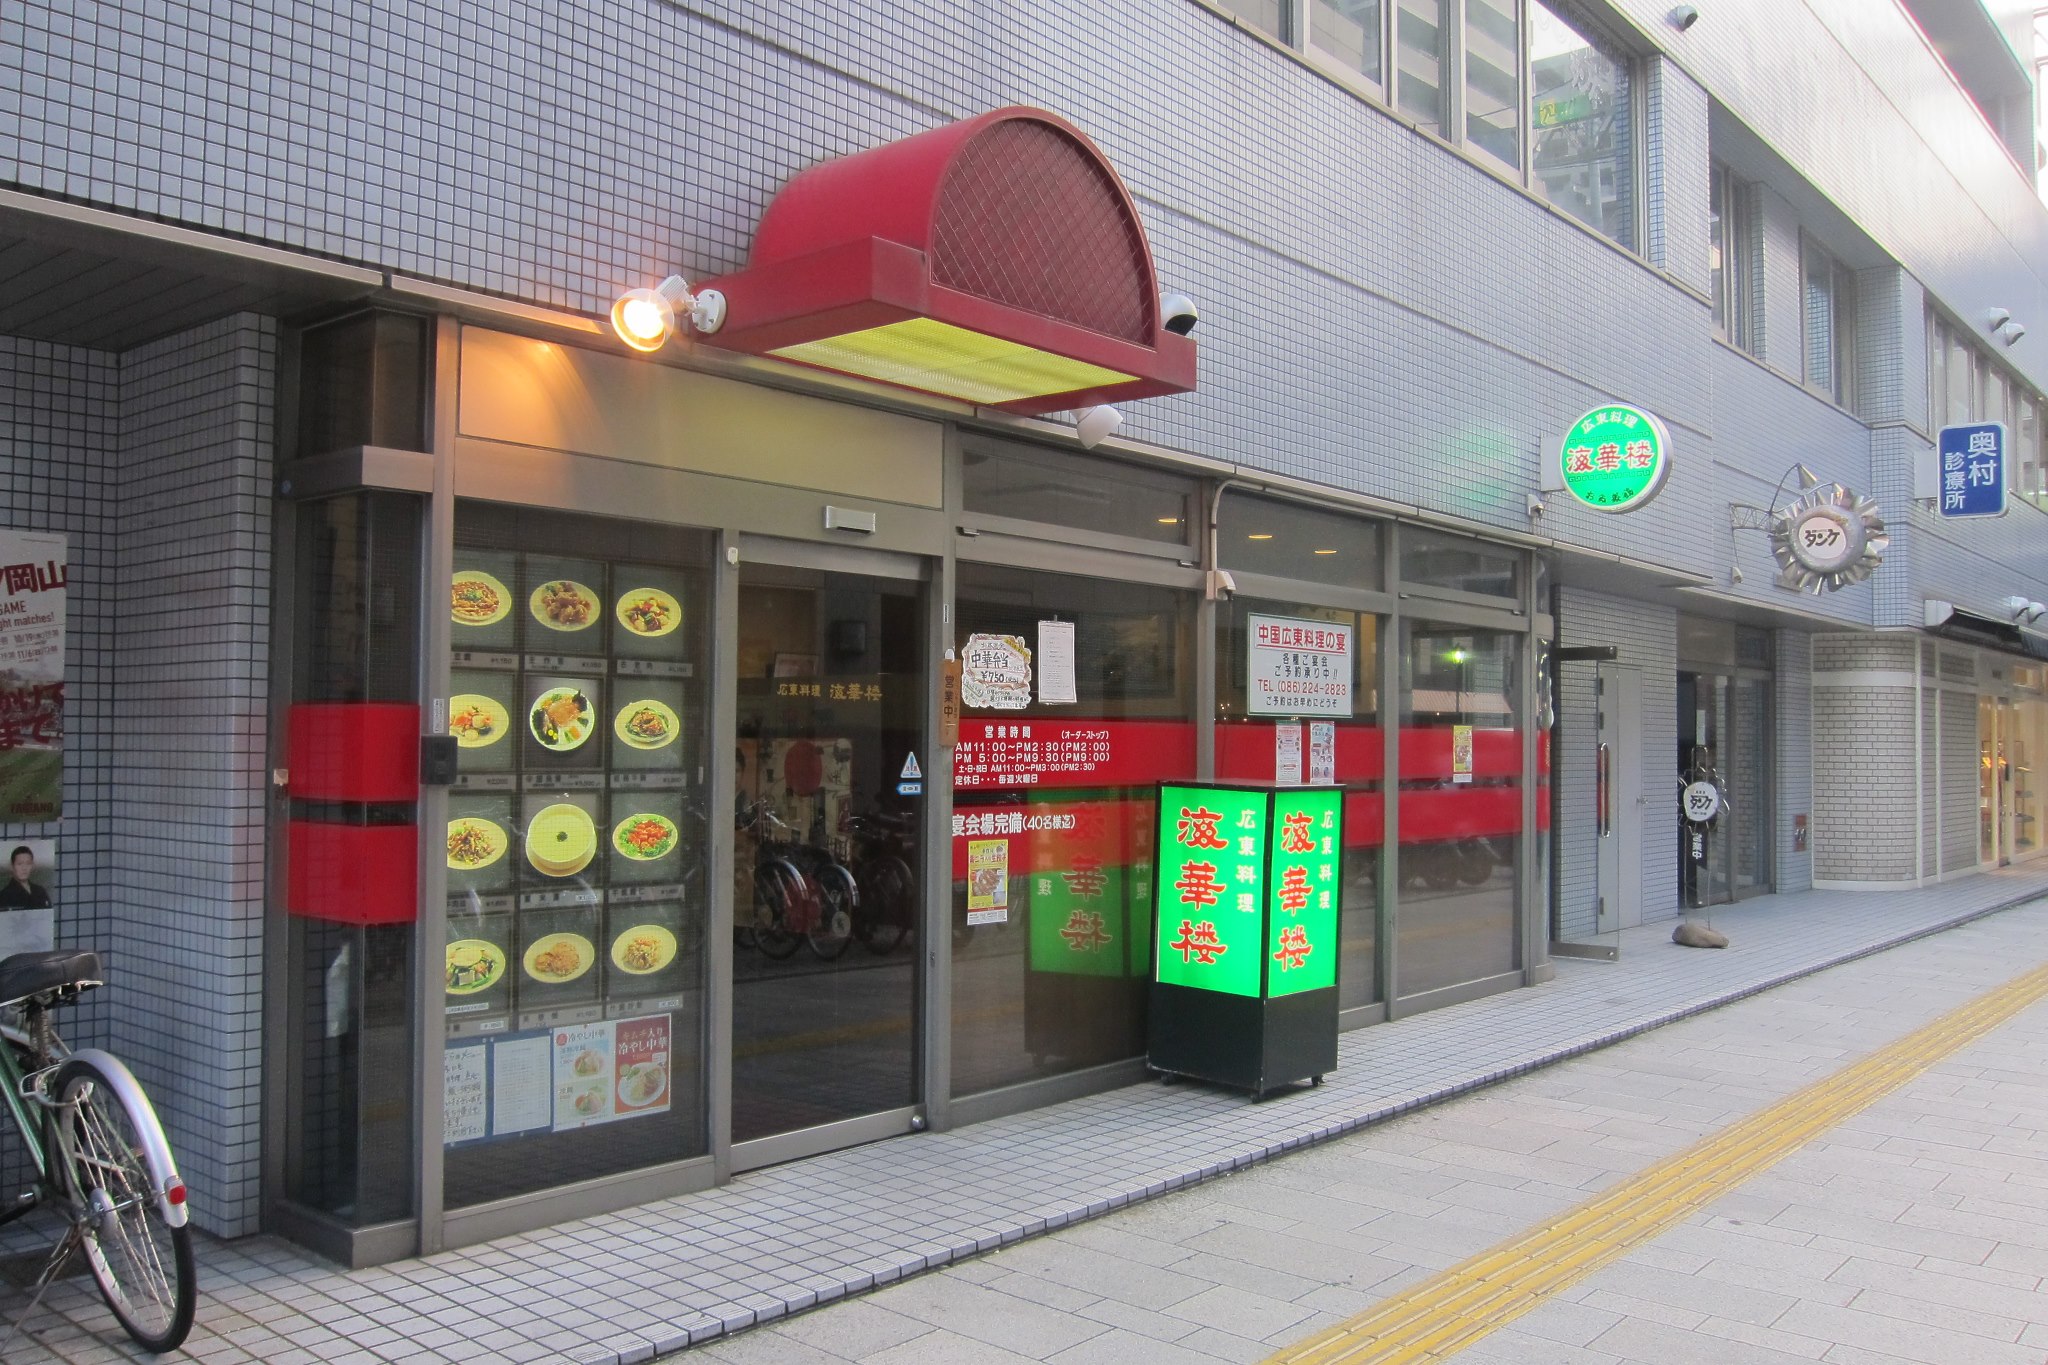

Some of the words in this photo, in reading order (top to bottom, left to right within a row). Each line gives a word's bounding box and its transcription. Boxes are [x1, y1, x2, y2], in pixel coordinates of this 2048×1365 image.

[1581, 411, 1638, 434] 広東料理
[1967, 431, 1997, 487] 奥村
[1945, 451, 1966, 510] 診療所
[0, 561, 67, 596] 岡山
[14, 611, 55, 627] matches!
[1258, 624, 1346, 651] 中国広東料理の宴
[971, 650, 1009, 669] 中華弁当
[1282, 653, 1328, 667] 各種ご宴会
[944, 675, 954, 718] 営業中
[1258, 679, 1274, 692] TEL
[1278, 681, 1346, 695] (086)224-2823
[985, 725, 1031, 739] 営業時間
[1061, 730, 1110, 740] (オーダーストップ)
[955, 753, 972, 763] PM
[1236, 809, 1257, 913] 広東料理
[1318, 810, 1334, 909] 広東料理
[618, 1036, 667, 1055] 冷やし中華
